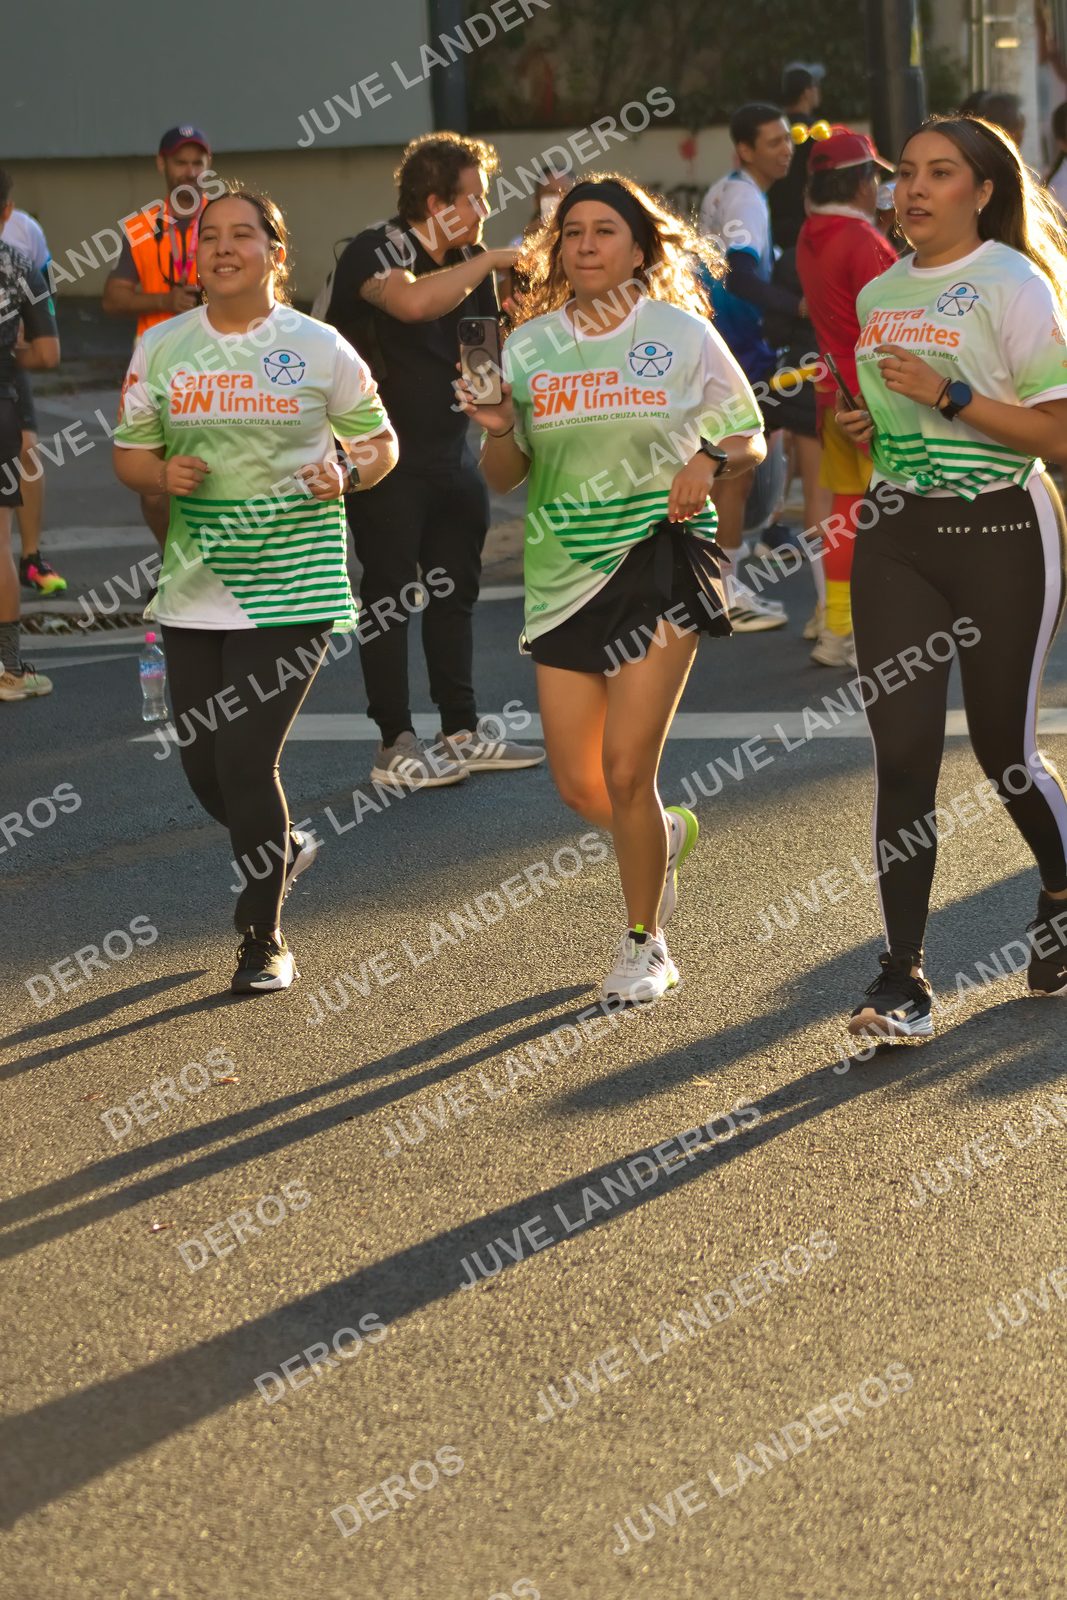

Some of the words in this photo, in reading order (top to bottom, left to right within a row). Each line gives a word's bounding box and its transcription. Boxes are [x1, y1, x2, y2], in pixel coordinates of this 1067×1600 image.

[887, 322, 961, 348] límites
[171, 371, 253, 391] Carrera
[531, 371, 619, 393] Carrera
[170, 390, 215, 415] SIN
[219, 392, 300, 414] límites
[533, 390, 579, 417] SIN
[584, 387, 668, 409] límites
[200, 418, 243, 426] VOLUNTAD
[244, 418, 270, 426] CRUZA
[565, 413, 609, 425] VOLUNTAD
[610, 412, 637, 420] CRUZA
[649, 411, 670, 419] META
[982, 521, 1032, 534] ACTIVE
